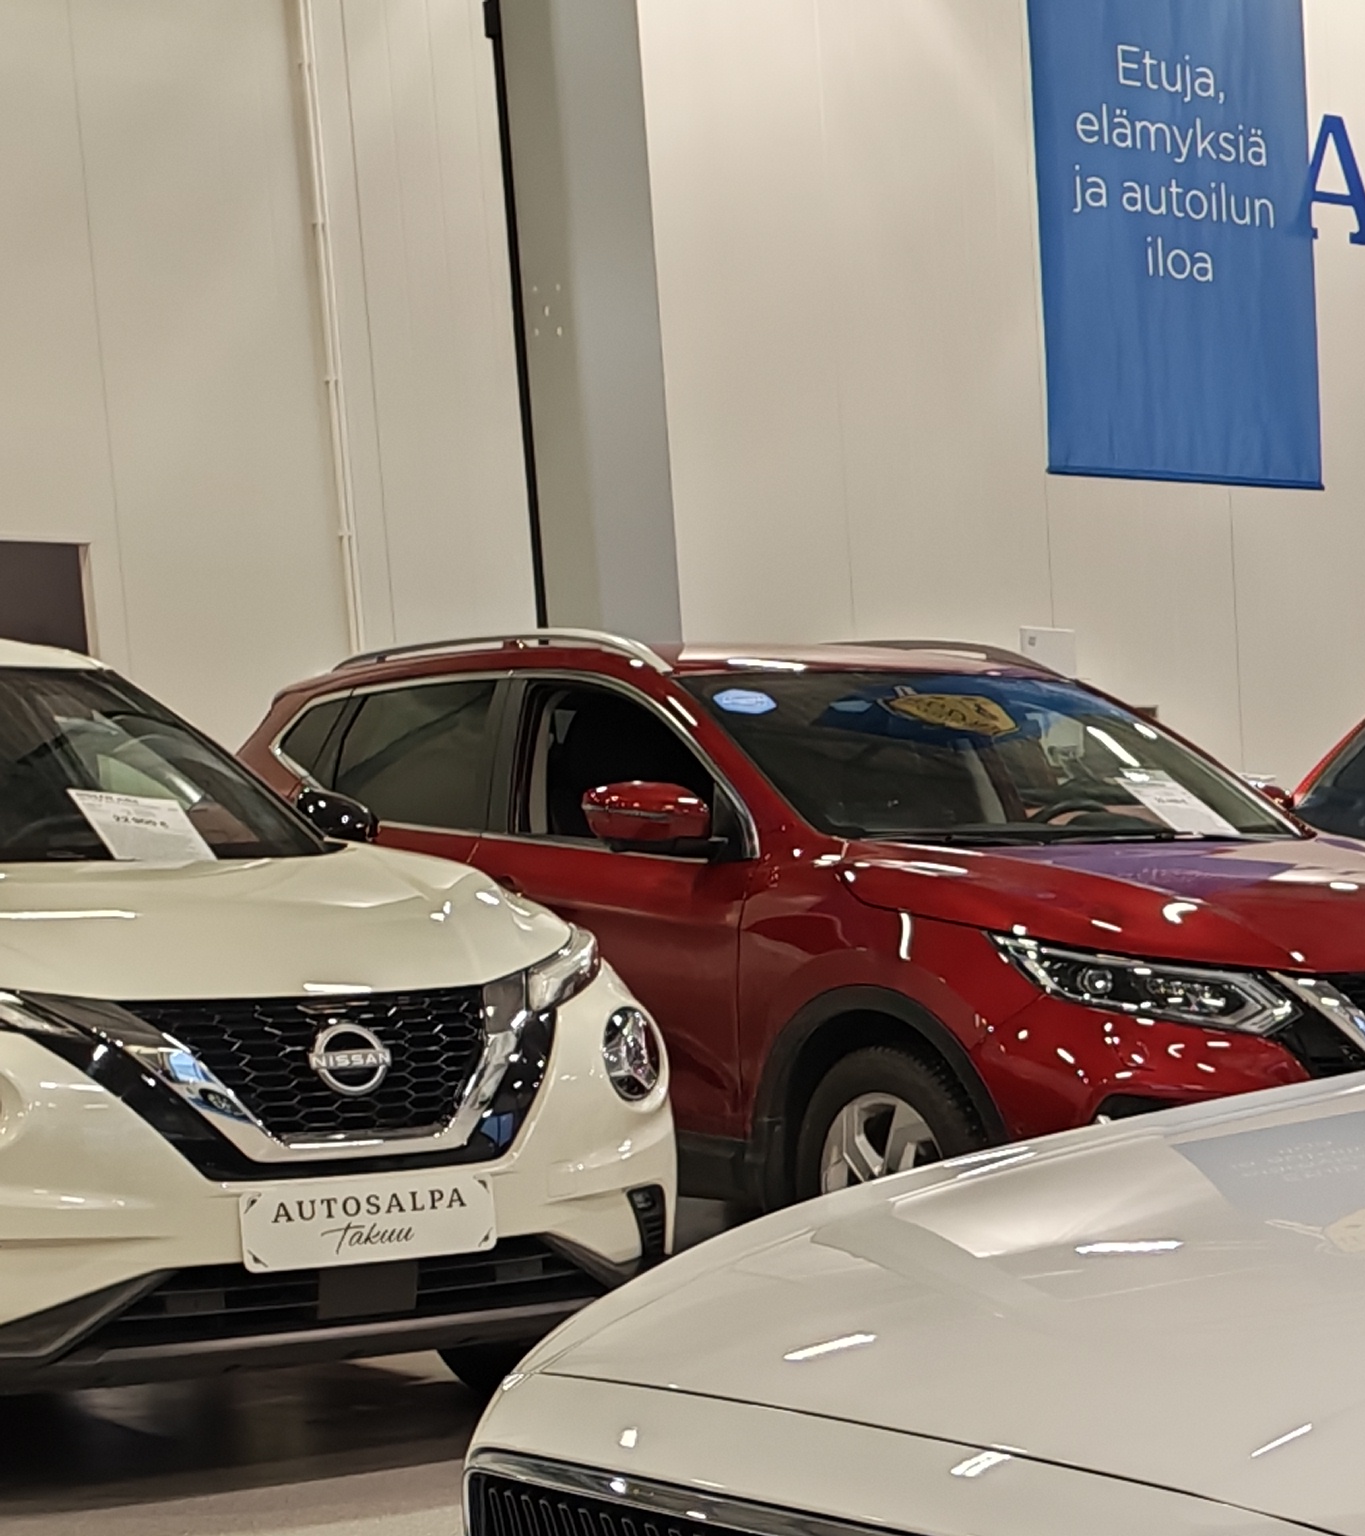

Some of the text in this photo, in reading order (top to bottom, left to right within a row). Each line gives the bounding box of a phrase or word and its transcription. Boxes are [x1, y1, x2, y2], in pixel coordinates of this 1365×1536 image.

[1116, 44, 1226, 104] Etuja,
[1075, 103, 1268, 166] elämyksiä
[1072, 164, 1275, 229] ja autoilun
[1146, 236, 1214, 282] iloa
[313, 1051, 391, 1068] NISSAN
[272, 1187, 468, 1224] AUTOSALPA
[320, 1222, 416, 1255] Takuu
